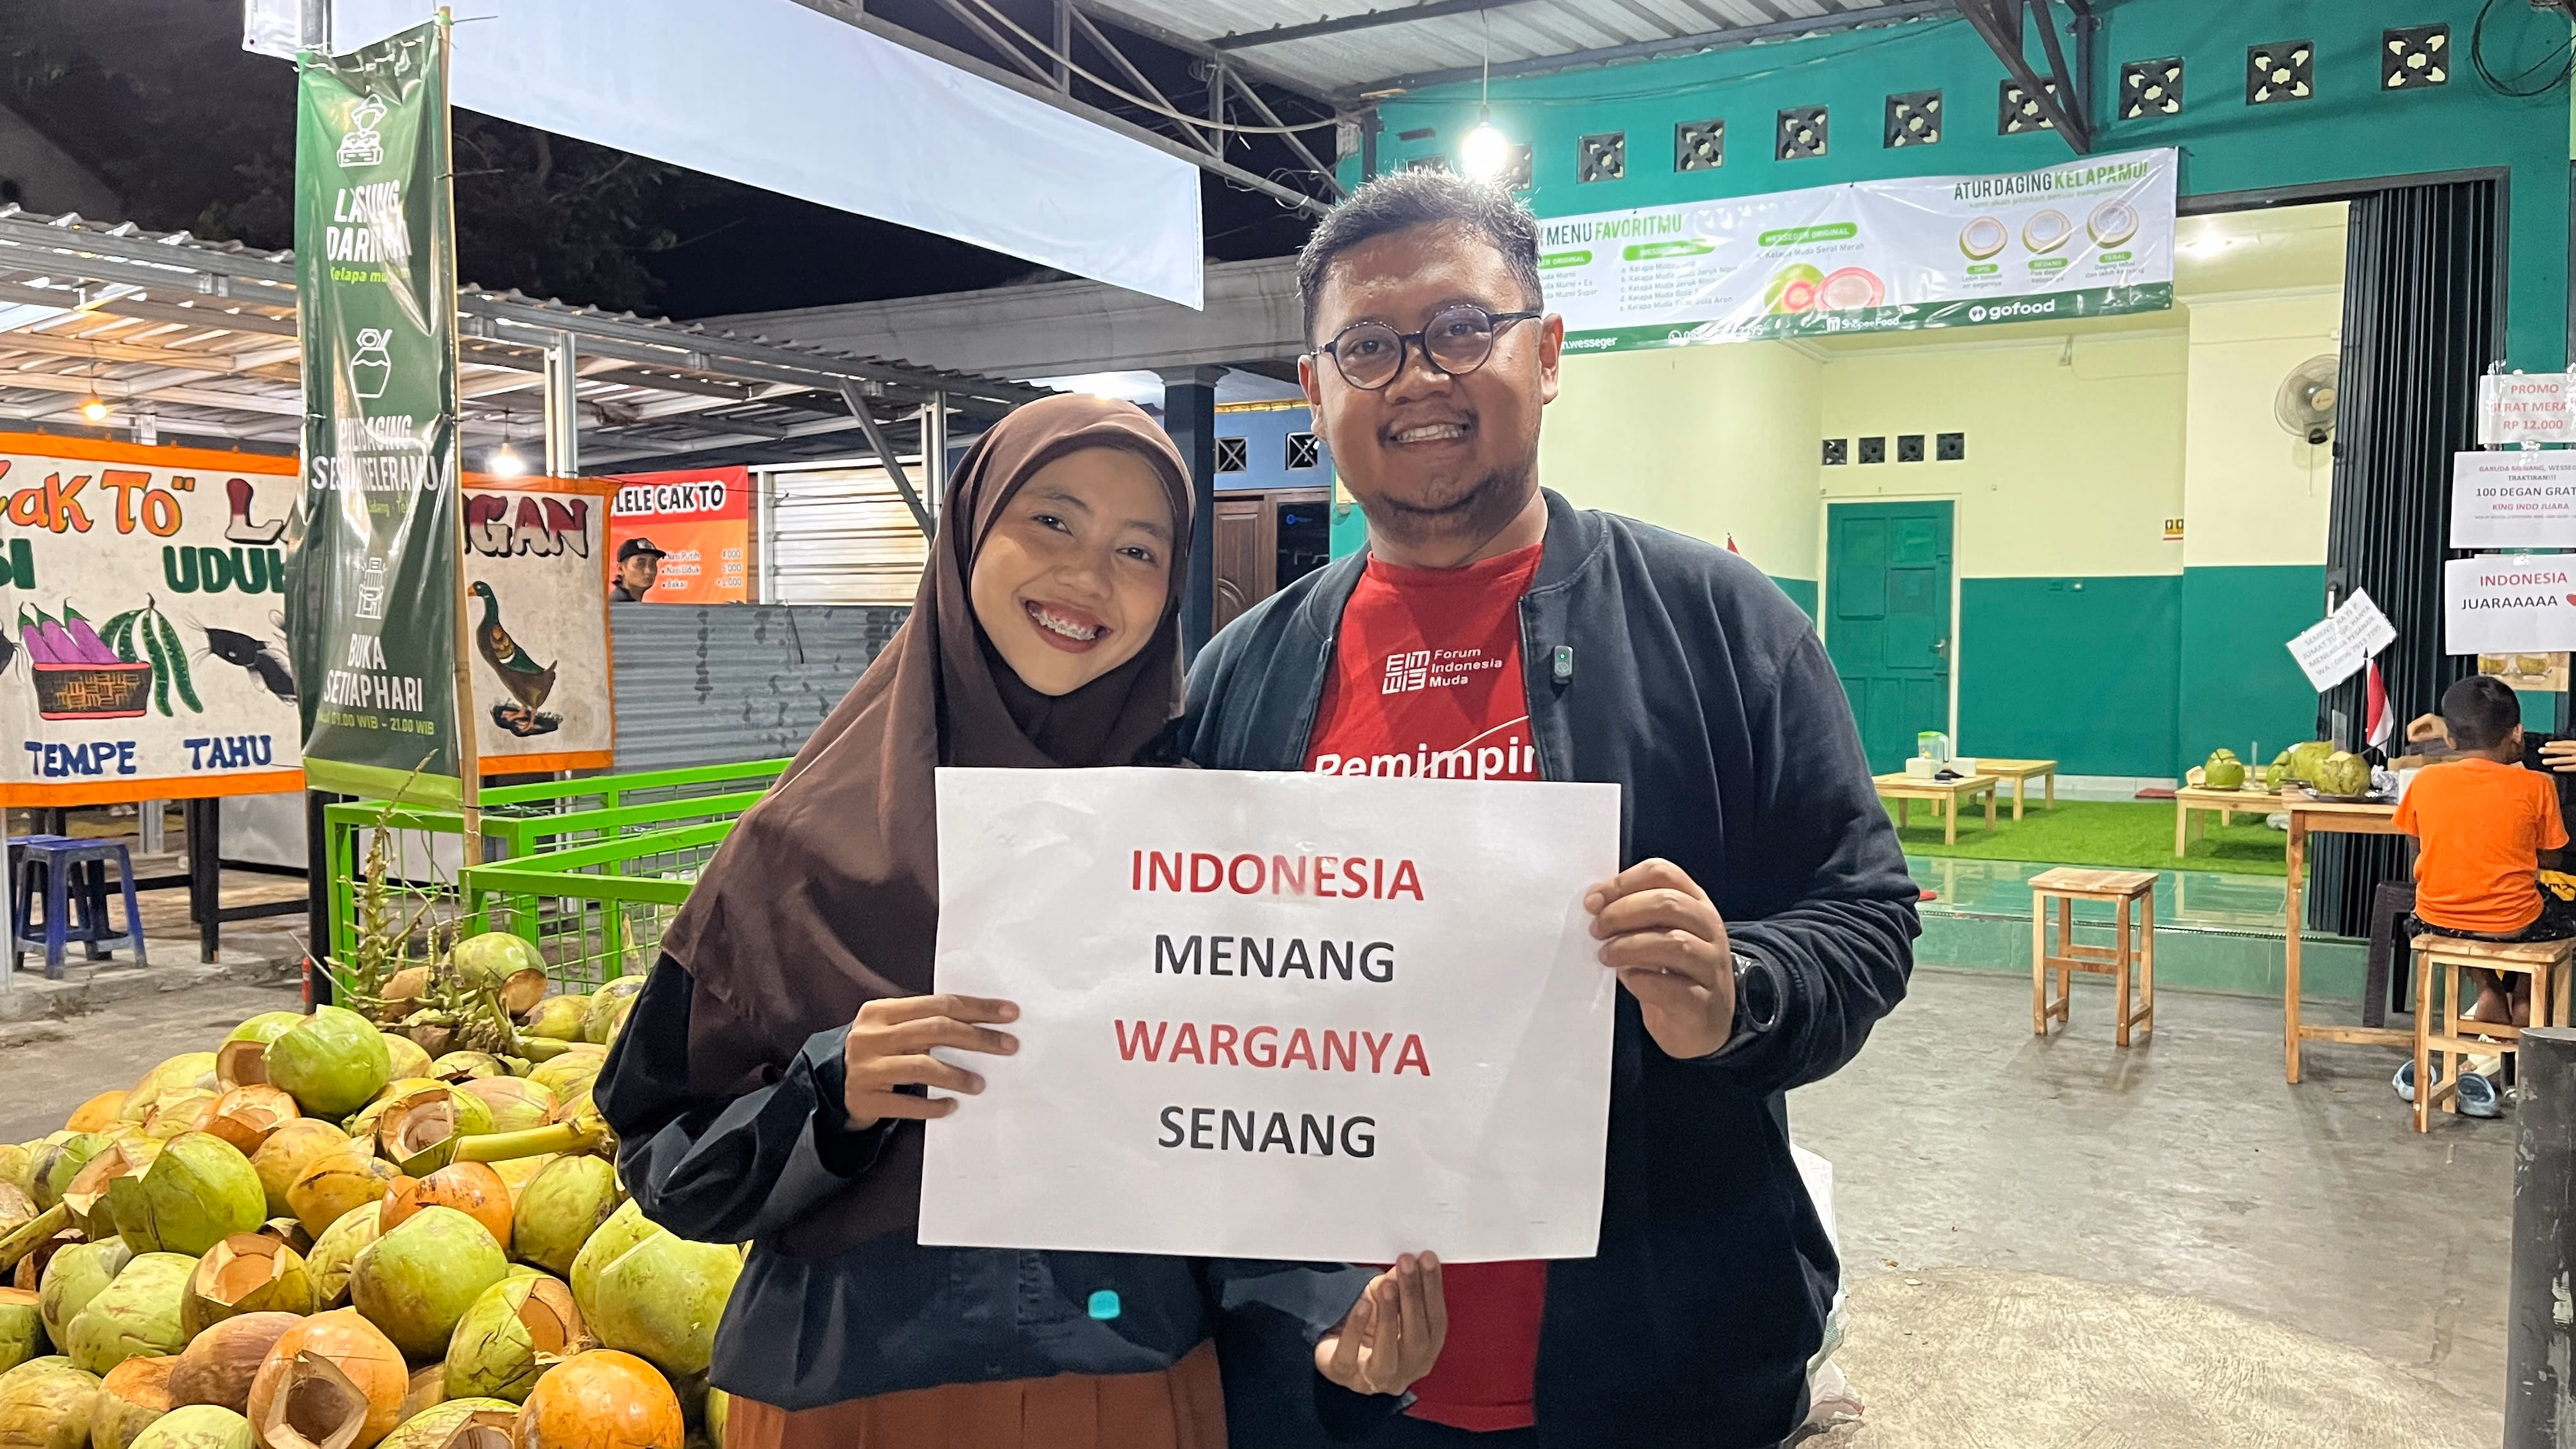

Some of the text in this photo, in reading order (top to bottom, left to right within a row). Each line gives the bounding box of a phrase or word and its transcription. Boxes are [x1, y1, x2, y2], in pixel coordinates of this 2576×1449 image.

[1954, 161, 2149, 201] ATUR DAGING KELAPAMU!
[1546, 223, 1592, 247] MENU
[1595, 213, 1682, 241] FAVORITMU
[1811, 227, 1850, 239] ORIGINAL
[1989, 298, 2055, 319] gofood
[1561, 336, 1618, 351] n.wesseger
[2511, 384, 2559, 394] PROMO
[2531, 401, 2567, 412] MERA
[2503, 420, 2564, 430] RP 12.000
[616, 484, 724, 512] LELE CAK TO
[2476, 487, 2497, 497] 100
[2499, 486, 2542, 497] DEGAN
[2540, 502, 2570, 510] JUARA
[2480, 572, 2568, 586] INDONESIA
[2461, 595, 2558, 610] JUARAAAAA
[348, 633, 387, 670] BUKA
[1434, 648, 1482, 659] Forum
[1430, 658, 1503, 673] Indonesia
[1429, 675, 1469, 688] Muda
[323, 669, 371, 709] SETIAP
[374, 675, 424, 712] HARI
[356, 715, 378, 730] WIB
[415, 719, 435, 735] WIB
[24, 735, 272, 778] TEMPE TAHU
[1131, 849, 1425, 901] INDONESIA
[1154, 933, 1395, 983] MENANG
[1114, 1018, 1431, 1077] WARGANYA
[1158, 1105, 1376, 1158] SENANG
